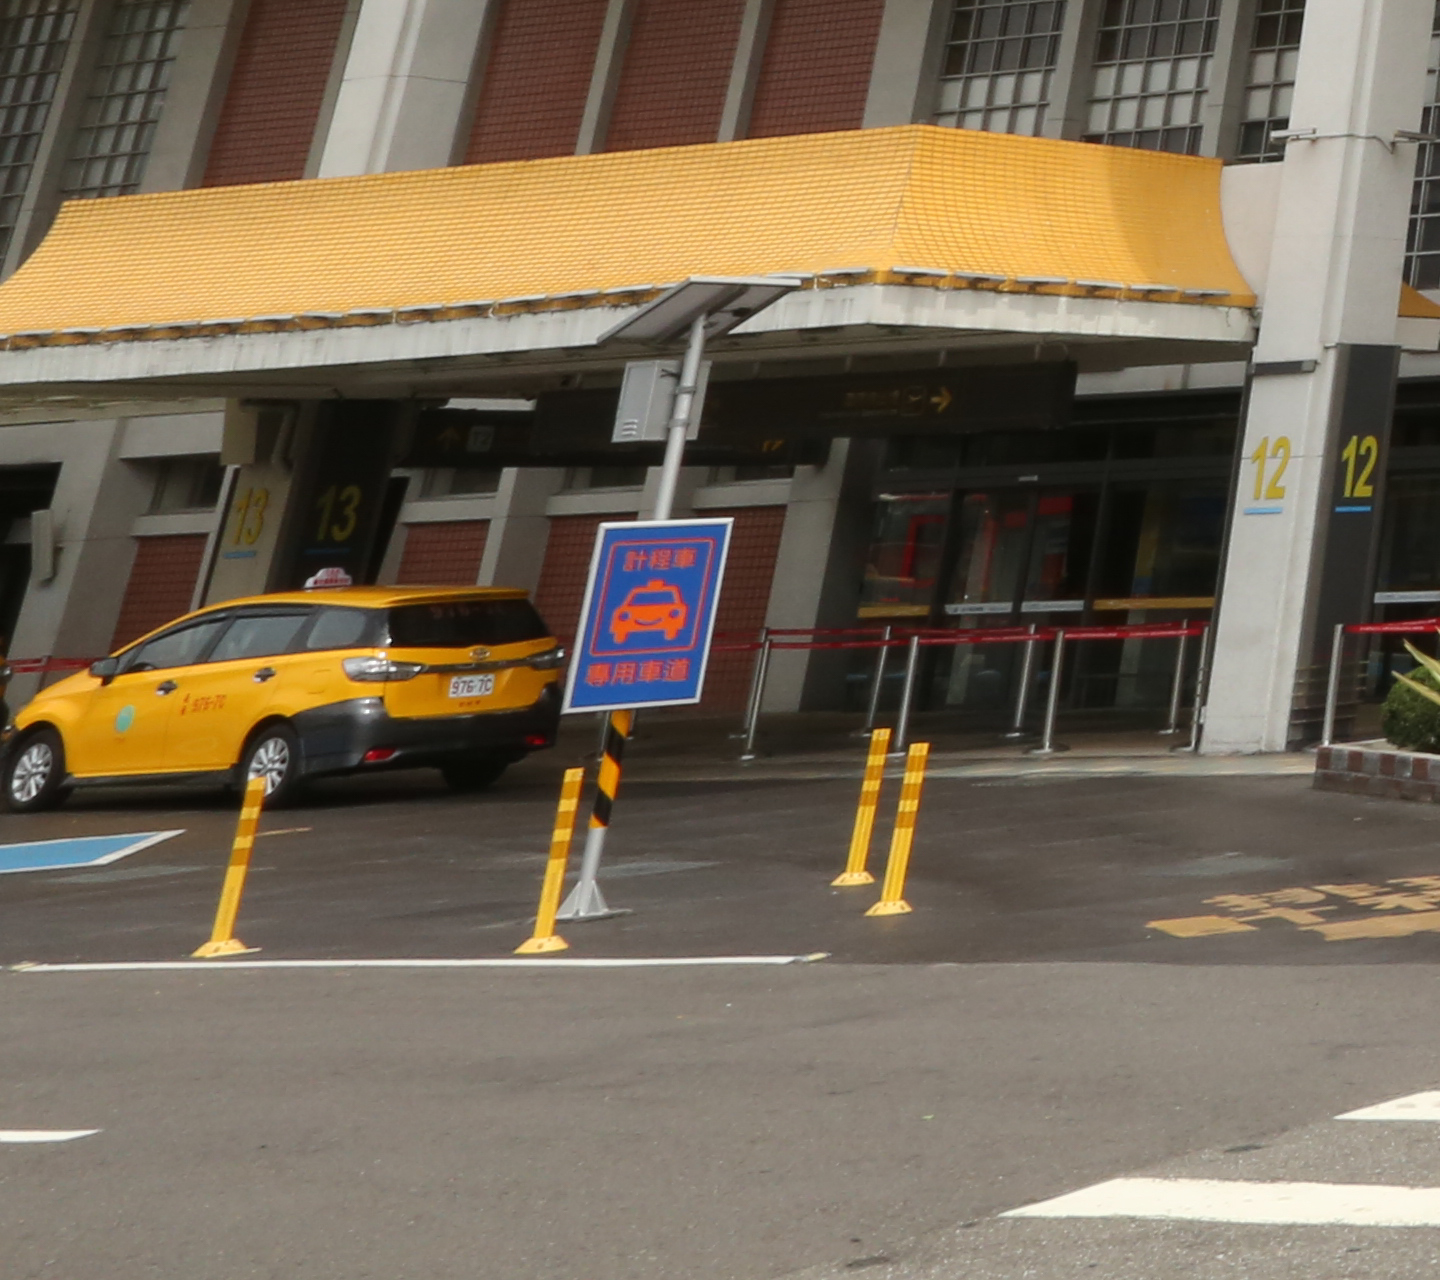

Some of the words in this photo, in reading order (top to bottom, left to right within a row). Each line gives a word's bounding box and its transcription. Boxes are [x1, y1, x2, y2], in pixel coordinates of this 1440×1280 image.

[1251, 435, 1292, 500] 12
[1341, 435, 1379, 498] 12
[232, 487, 269, 545] 13
[315, 484, 362, 542] 13
[623, 547, 697, 572] 計程車
[586, 657, 691, 686] 專用車道
